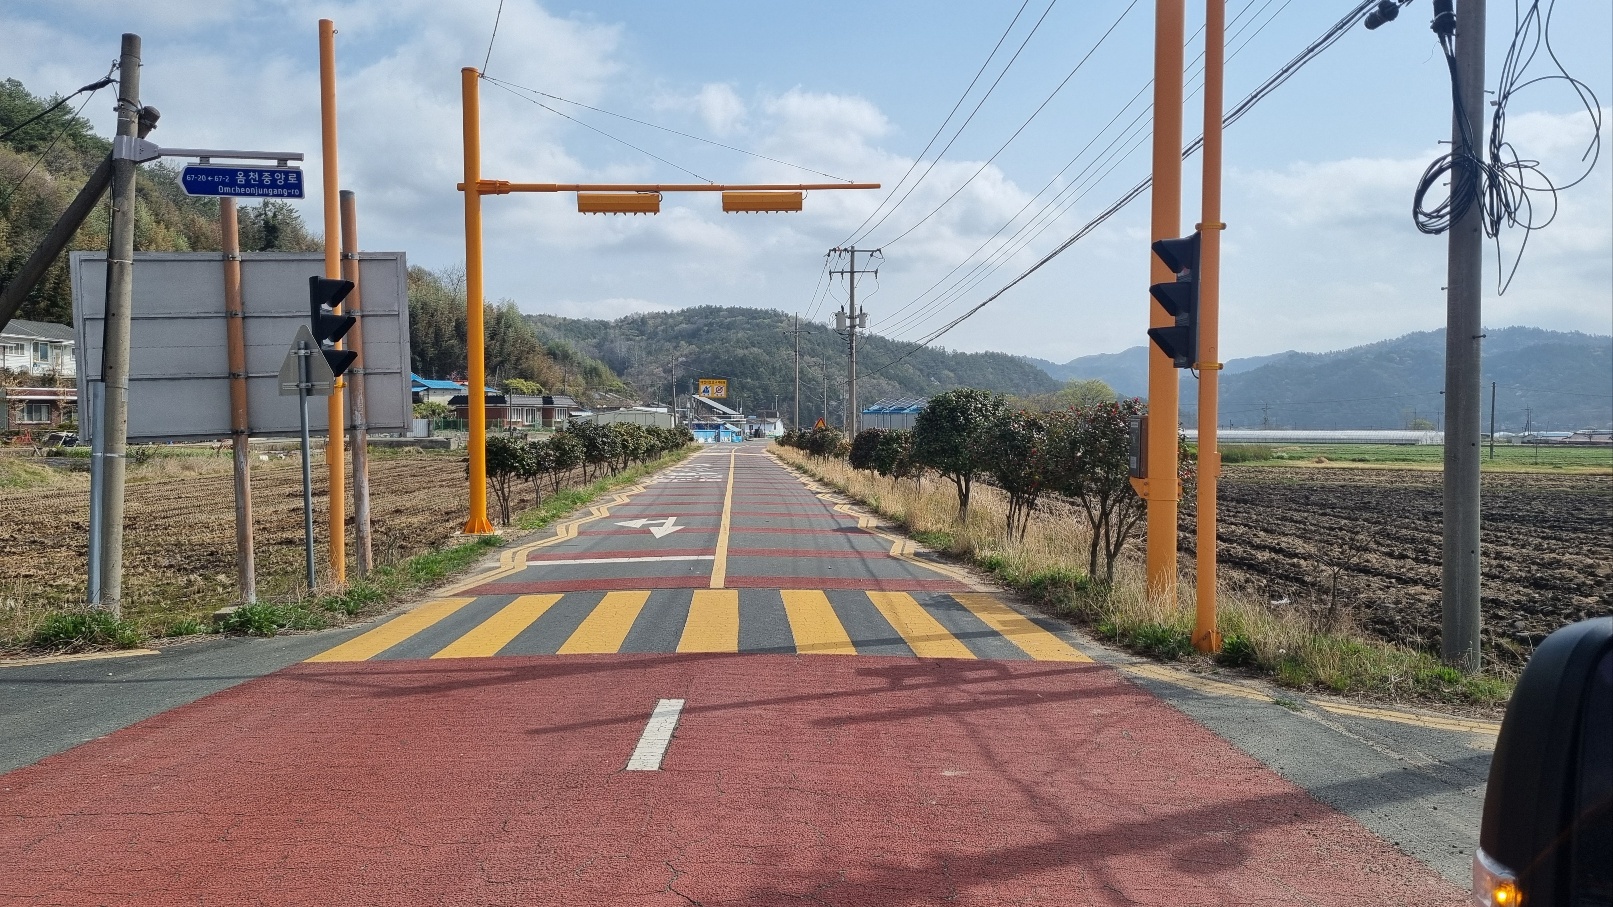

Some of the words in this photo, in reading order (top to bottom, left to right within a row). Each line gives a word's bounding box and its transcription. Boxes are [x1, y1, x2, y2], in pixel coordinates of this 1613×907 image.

[186, 174, 207, 182] 67-20
[235, 171, 299, 185] 옴천중앙로
[218, 185, 300, 196] Omcheonjungang-ro
